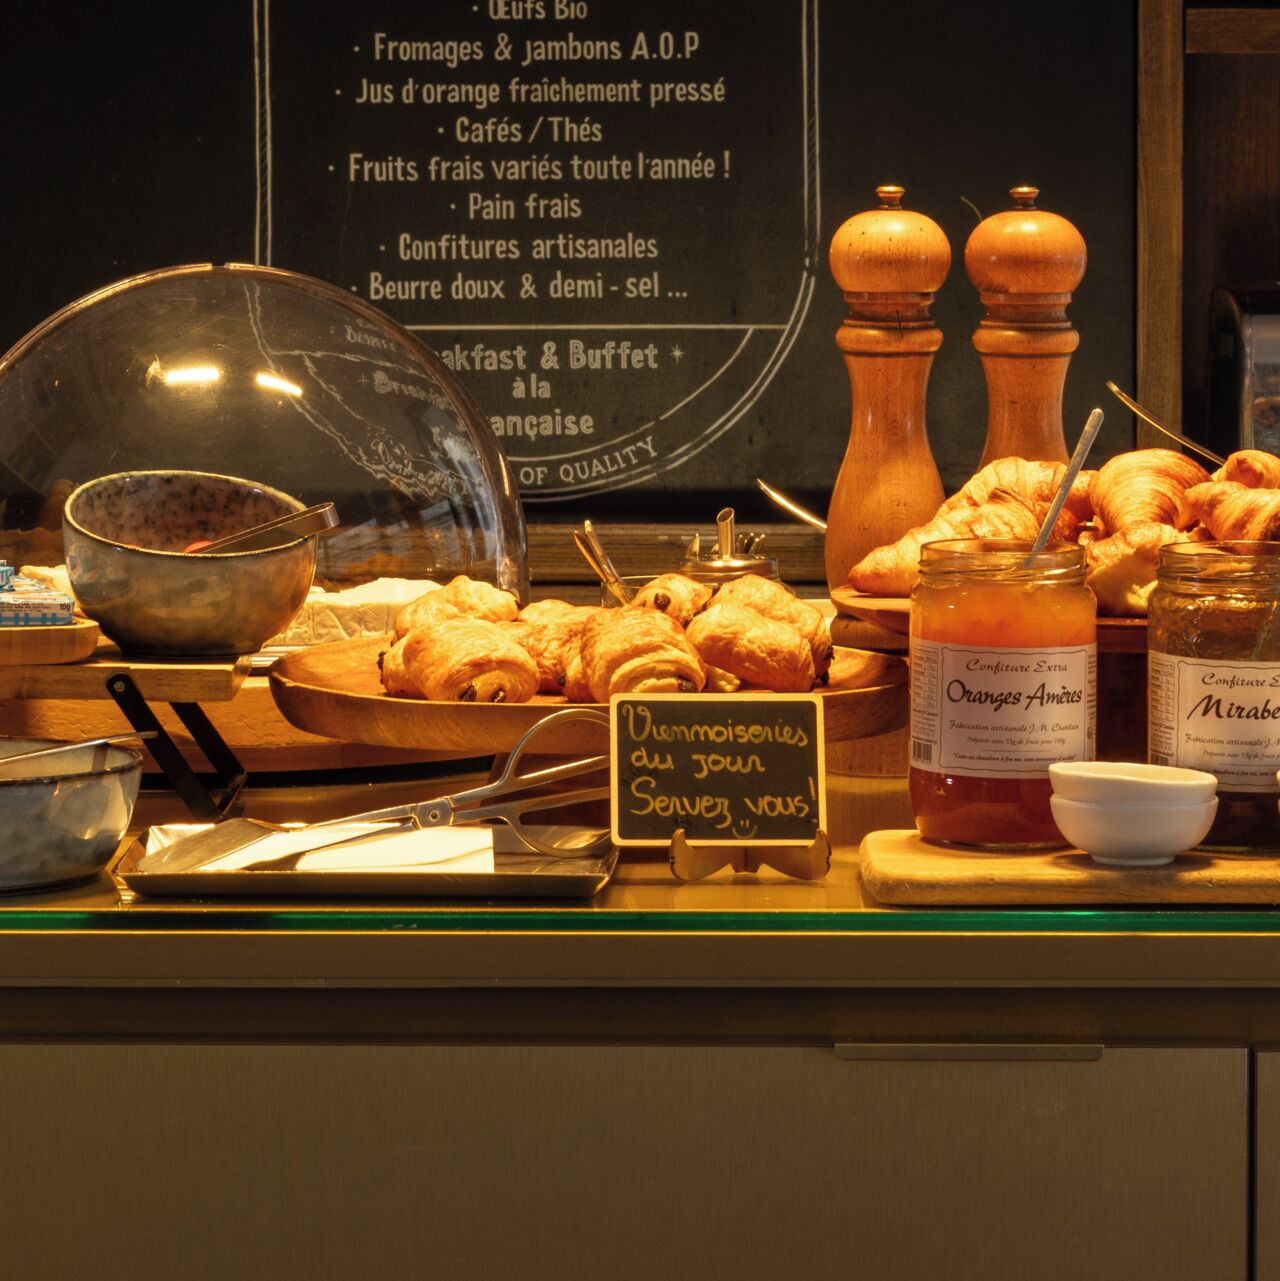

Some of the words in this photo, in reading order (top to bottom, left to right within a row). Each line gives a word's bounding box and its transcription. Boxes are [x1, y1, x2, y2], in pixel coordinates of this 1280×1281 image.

[374, 32, 484, 69] Fromages
[494, 32, 513, 61] &
[521, 31, 622, 67] jambons
[630, 31, 700, 60] A.O.P
[355, 78, 394, 104] Jus
[508, 76, 642, 103] fraîchement
[650, 76, 726, 108] pressé
[455, 116, 523, 143] Cafés
[547, 116, 603, 143] Thés
[349, 153, 419, 182] Fruits
[427, 155, 485, 181] frais
[490, 154, 563, 181] variés
[570, 154, 632, 180] toute
[469, 192, 515, 220] Pain
[524, 193, 582, 219] frais
[399, 233, 521, 261] Confitures
[532, 232, 659, 260] artisanales
[369, 271, 442, 300] Beurre
[451, 272, 506, 300] doux
[519, 273, 538, 299] &
[549, 270, 603, 299] demi
[625, 271, 659, 298] sel
[434, 343, 527, 371] akfast
[540, 341, 560, 370] &
[569, 340, 658, 370] Buffet
[512, 376, 525, 399] à
[530, 373, 551, 399] la
[488, 408, 595, 441] ançaise
[520, 467, 548, 485] OF
[559, 435, 658, 484] QUALITY
[59, 603, 71, 613] 10g
[966, 658, 1030, 675] Confiture
[1033, 660, 1068, 673] Extra
[1201, 672, 1266, 689] Confiture
[946, 679, 1022, 712] Oranges
[1024, 682, 1082, 710] Amères
[630, 746, 674, 770] du
[630, 776, 732, 829] Servez
